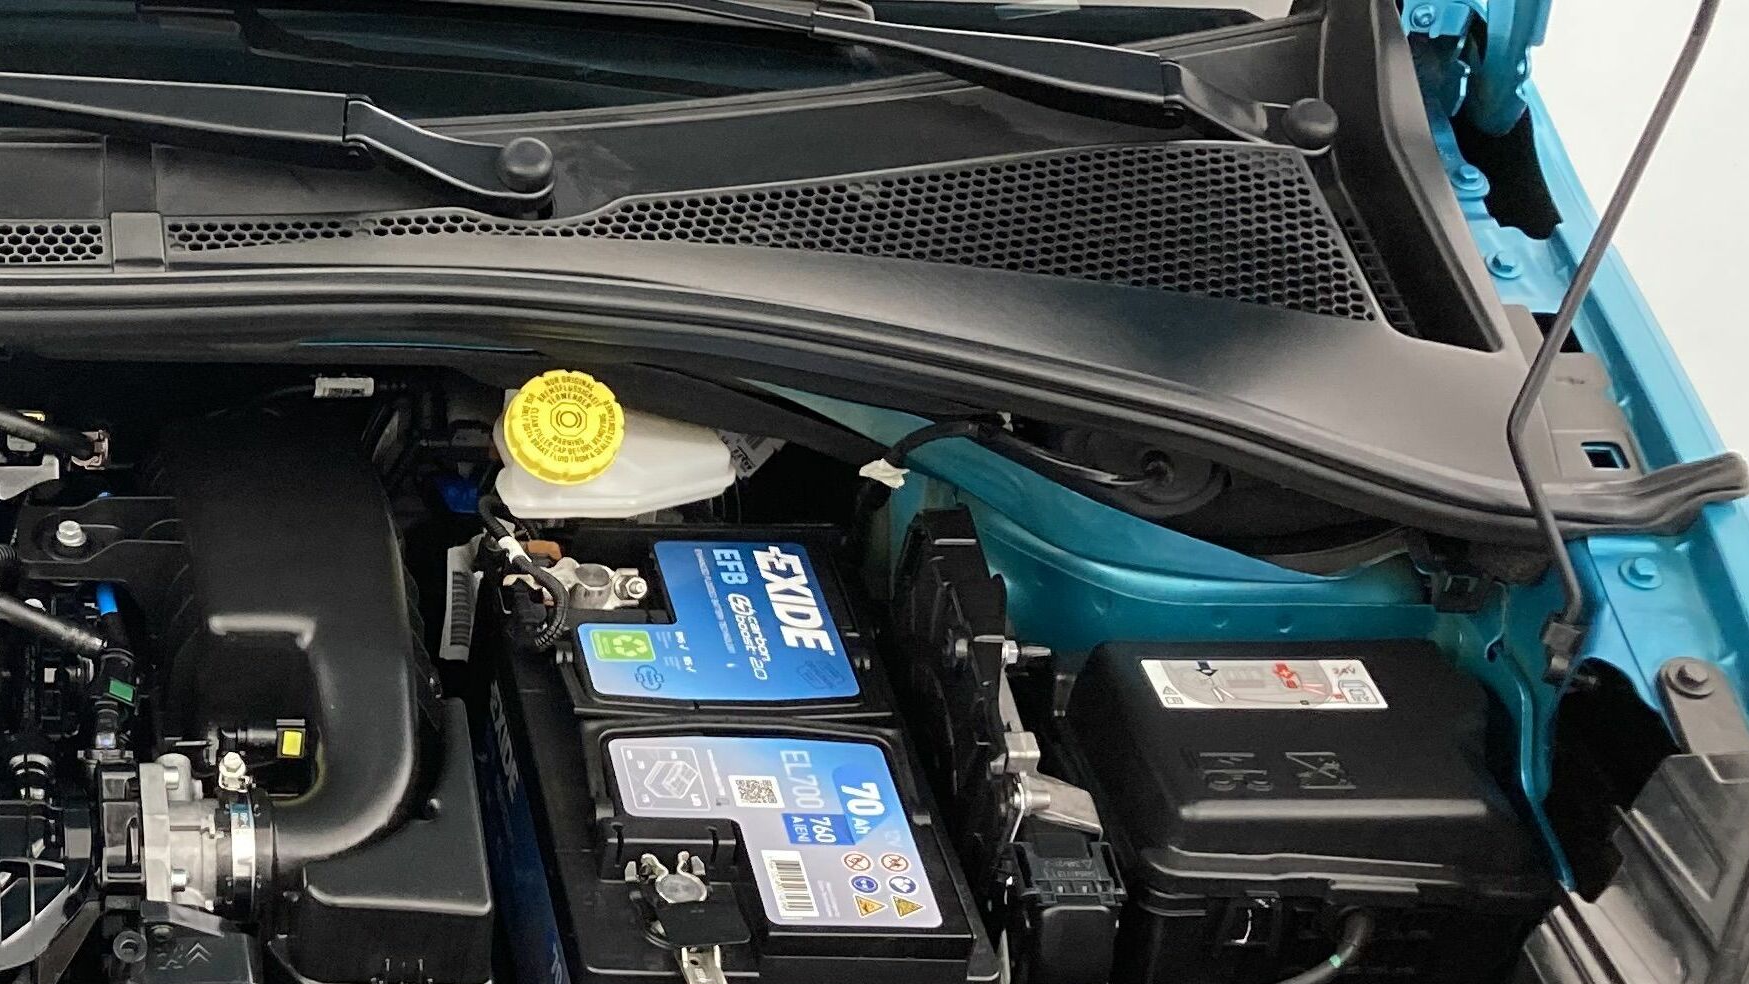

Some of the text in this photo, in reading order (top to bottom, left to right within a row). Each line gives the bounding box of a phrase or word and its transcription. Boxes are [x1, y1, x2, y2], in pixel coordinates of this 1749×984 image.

[713, 549, 748, 585] EFB
[753, 546, 835, 651] EXIDE
[780, 750, 825, 808] EL700
[810, 816, 837, 843] 760
[841, 782, 886, 835] 70 Ah
